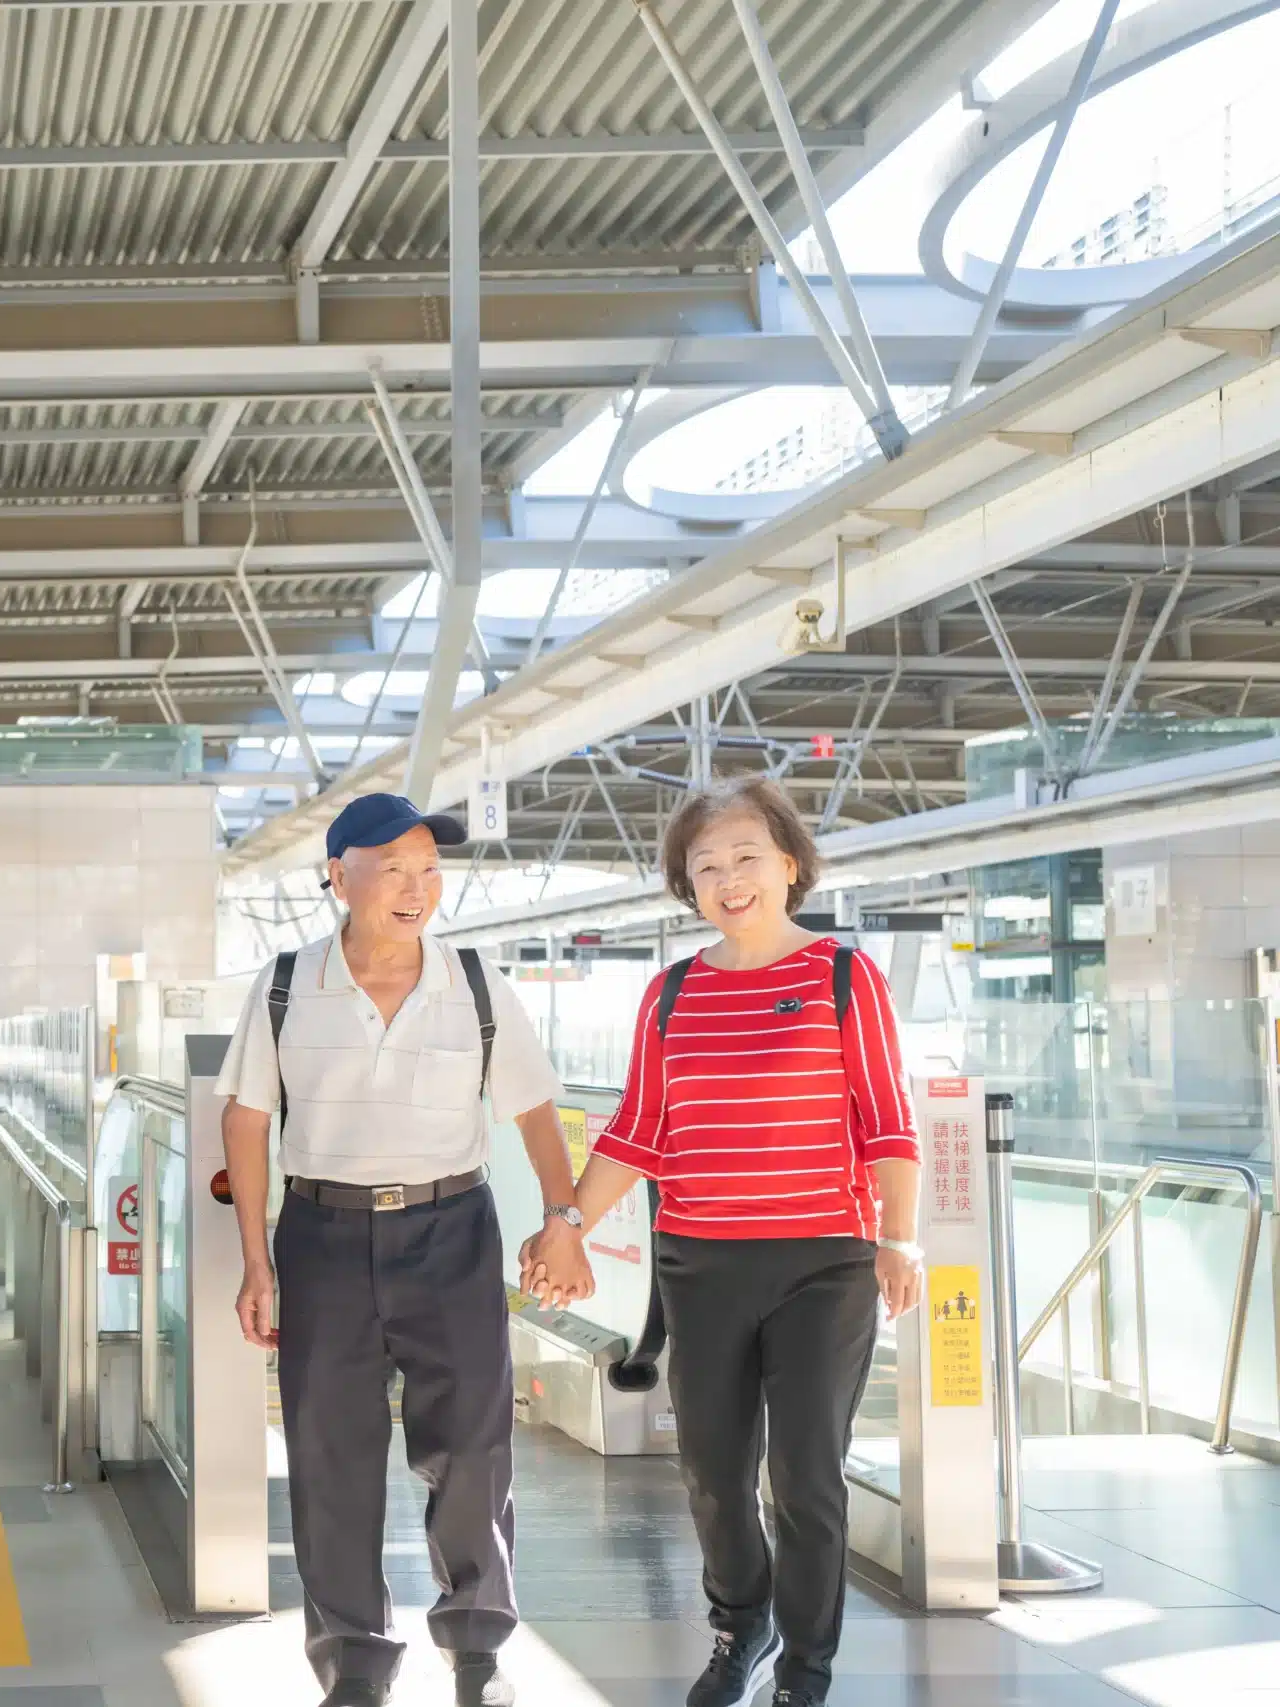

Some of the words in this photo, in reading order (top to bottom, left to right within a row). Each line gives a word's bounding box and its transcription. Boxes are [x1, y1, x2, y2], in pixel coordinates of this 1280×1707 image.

[484, 804, 497, 830] 8
[932, 1120, 951, 1212] 請緊握扶手
[952, 1121, 972, 1212] 扶梯速度快
